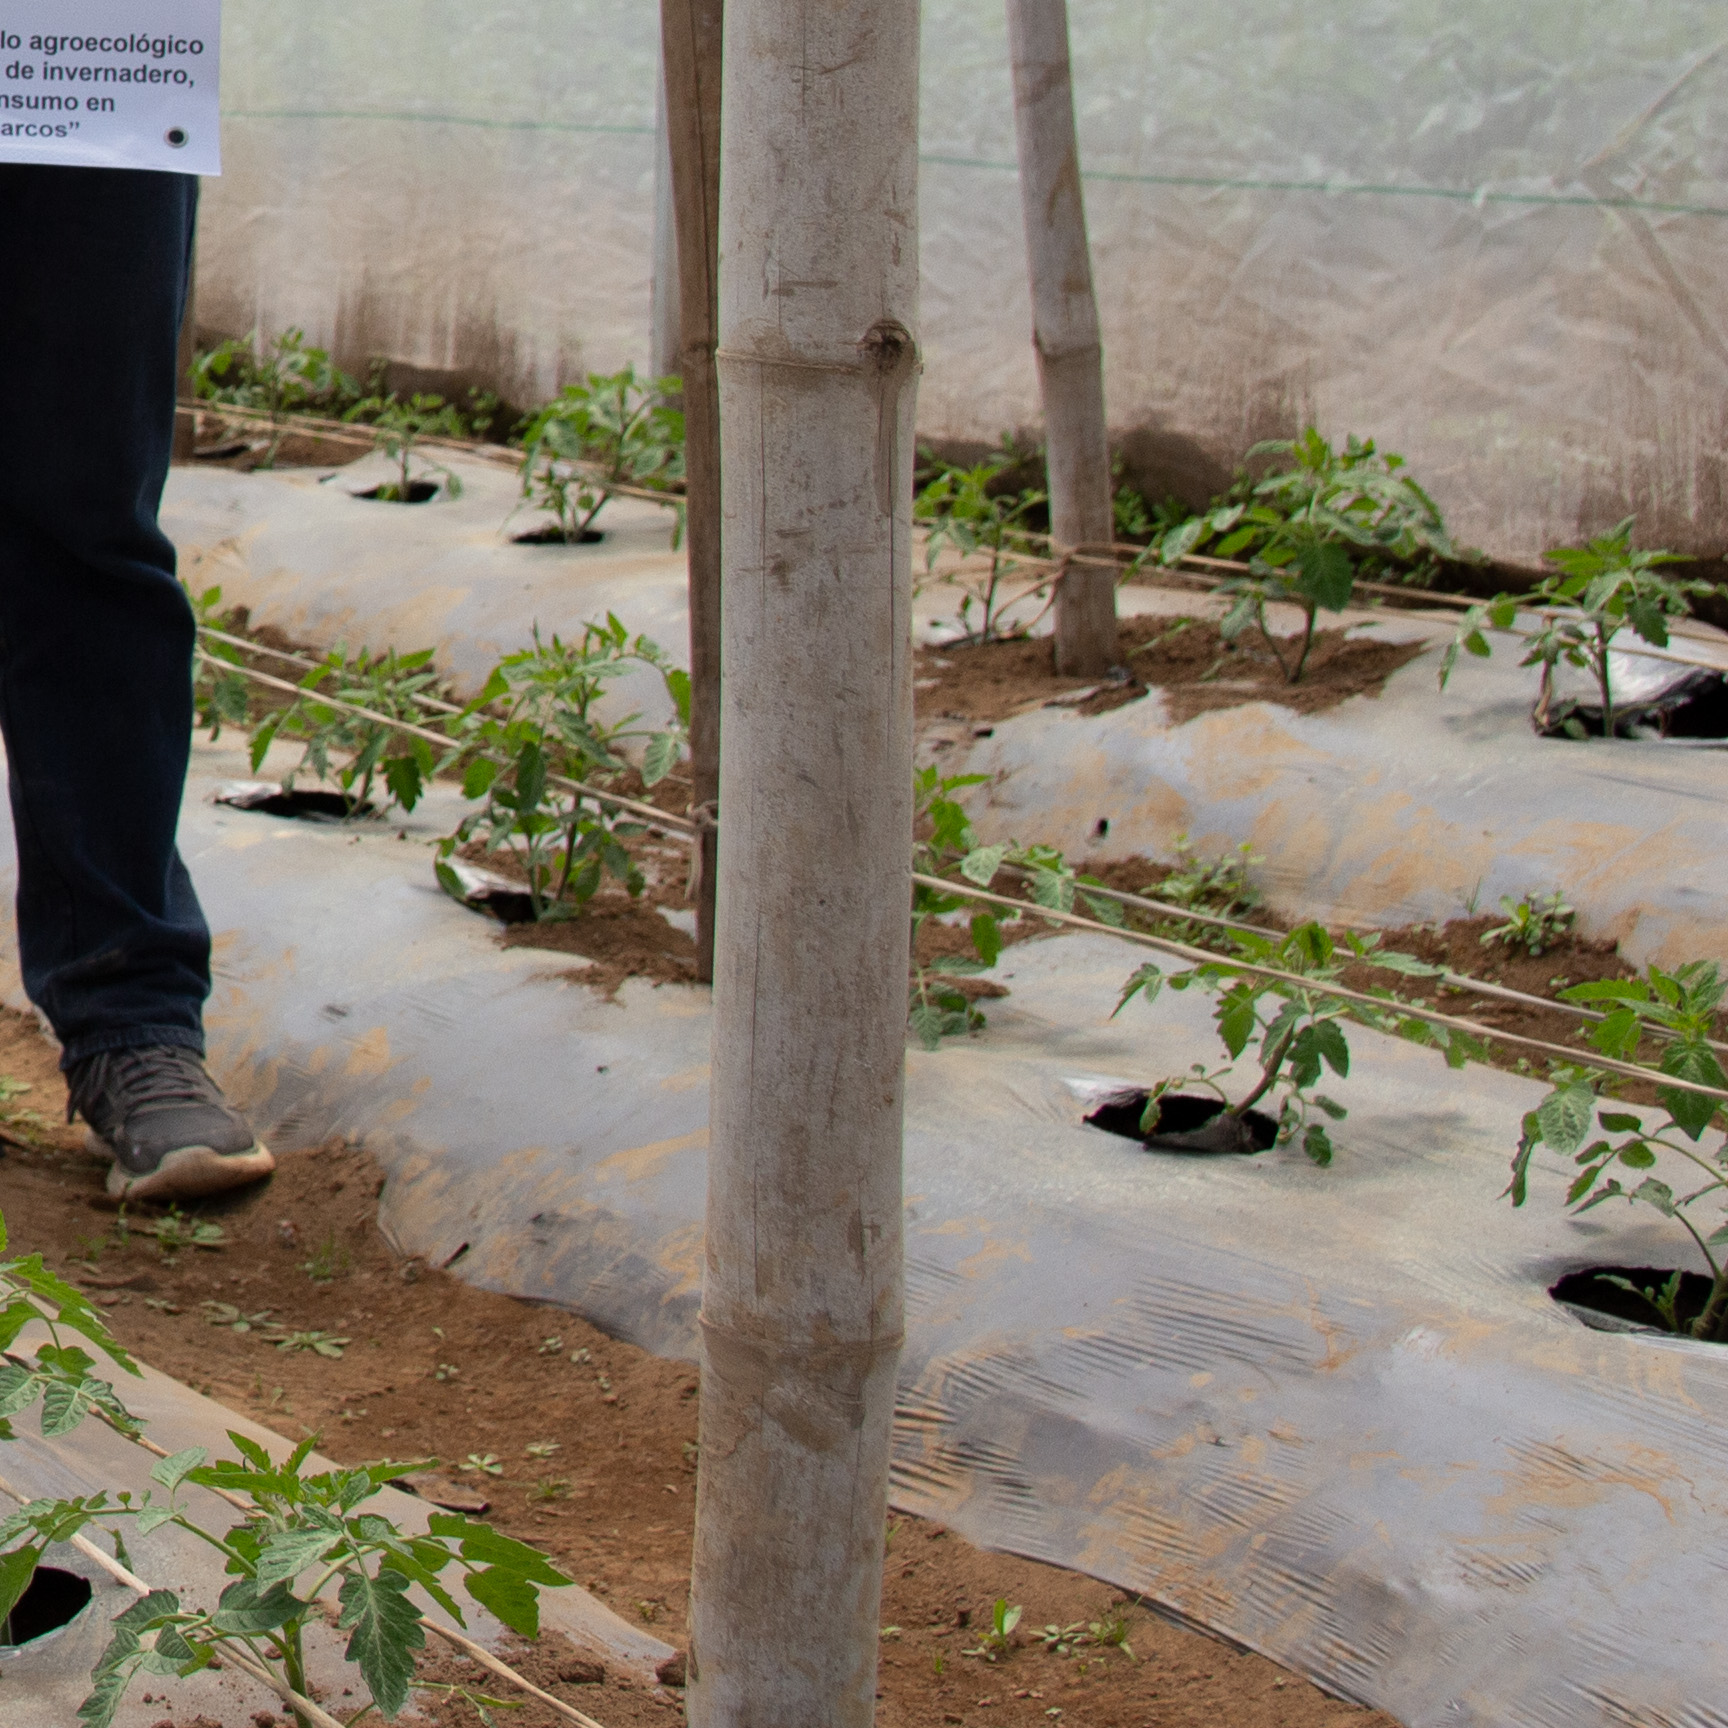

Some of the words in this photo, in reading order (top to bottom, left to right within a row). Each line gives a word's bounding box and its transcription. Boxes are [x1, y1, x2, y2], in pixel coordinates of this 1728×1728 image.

[29, 34, 204, 60] agroecológico
[6, 60, 34, 80] de
[43, 61, 195, 89] invernadero,
[86, 96, 115, 113] en
